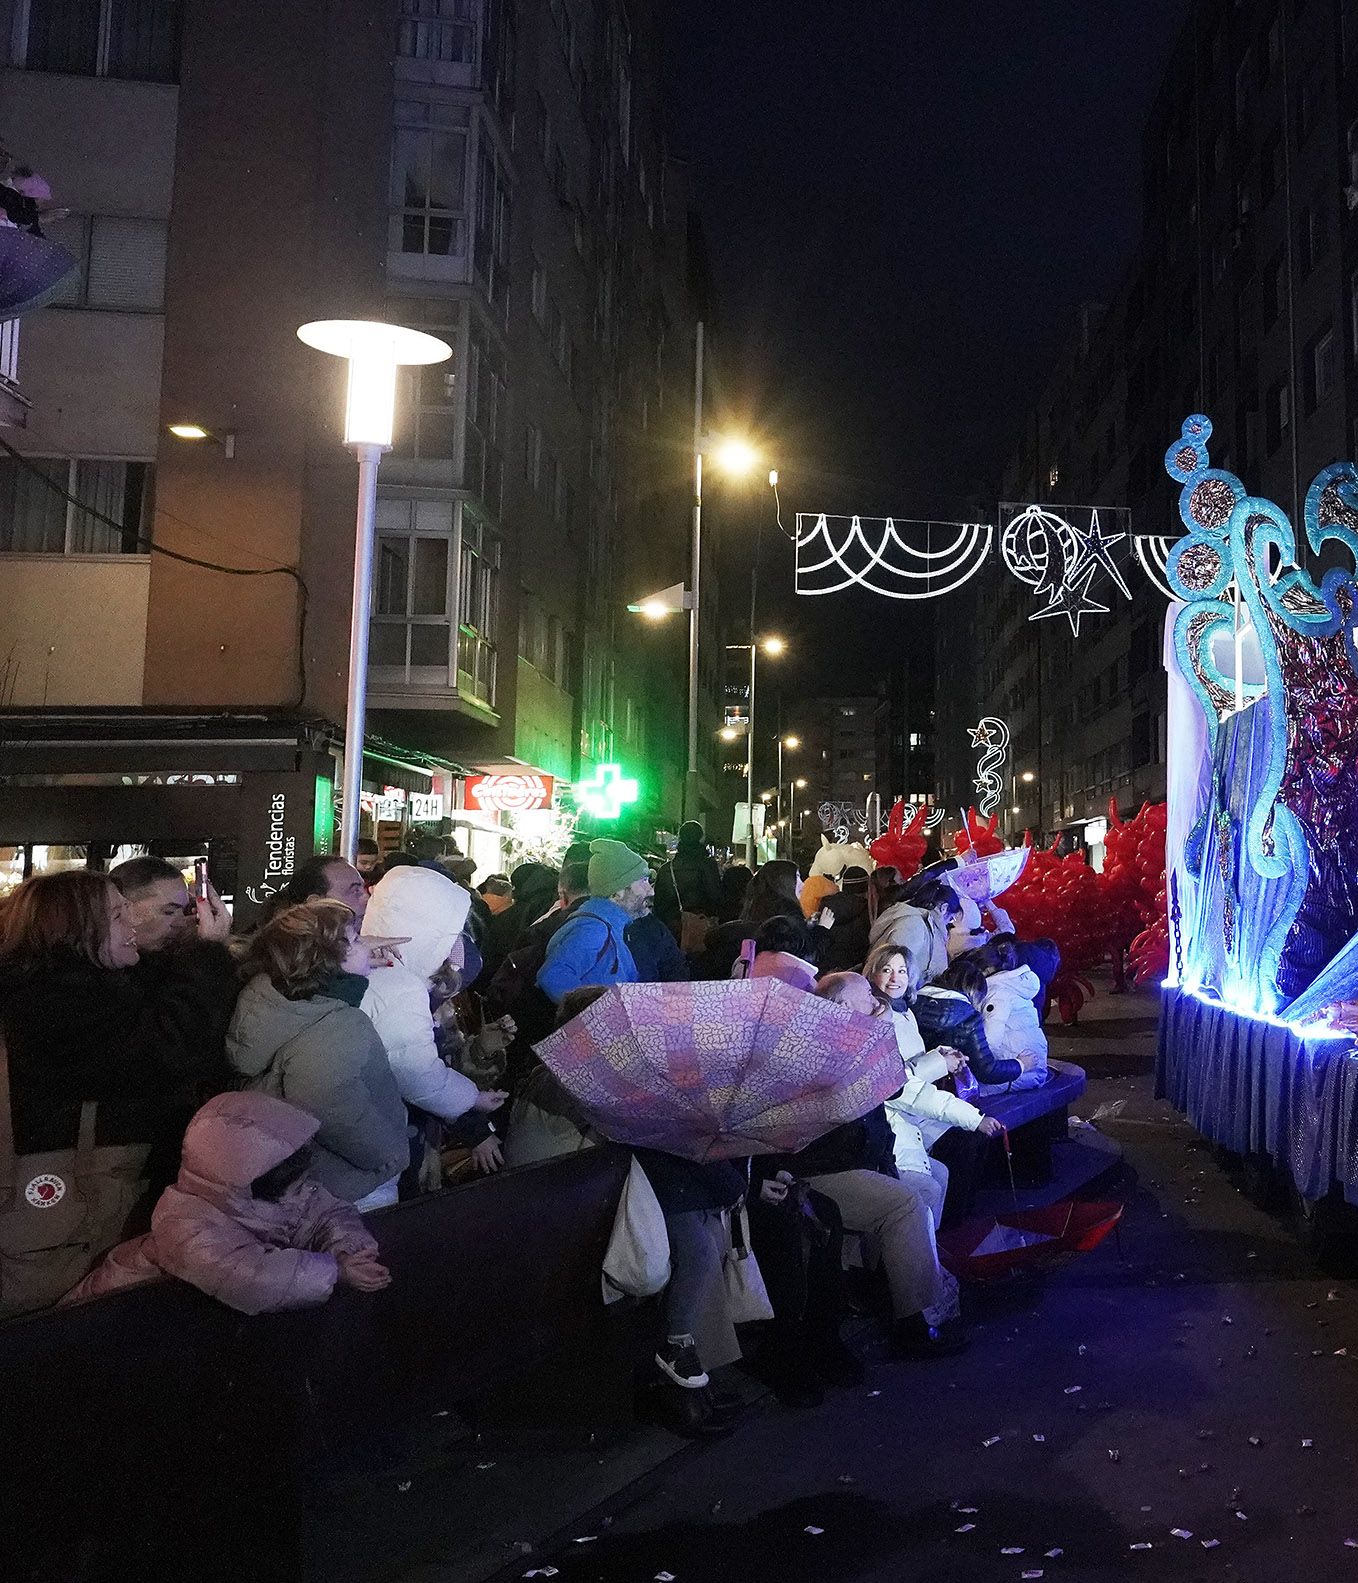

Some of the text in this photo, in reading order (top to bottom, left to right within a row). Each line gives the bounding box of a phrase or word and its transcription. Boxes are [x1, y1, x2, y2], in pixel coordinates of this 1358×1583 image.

[415, 798, 438, 817] 24H
[264, 793, 286, 880] Tendencias
[281, 836, 296, 876] floristas
